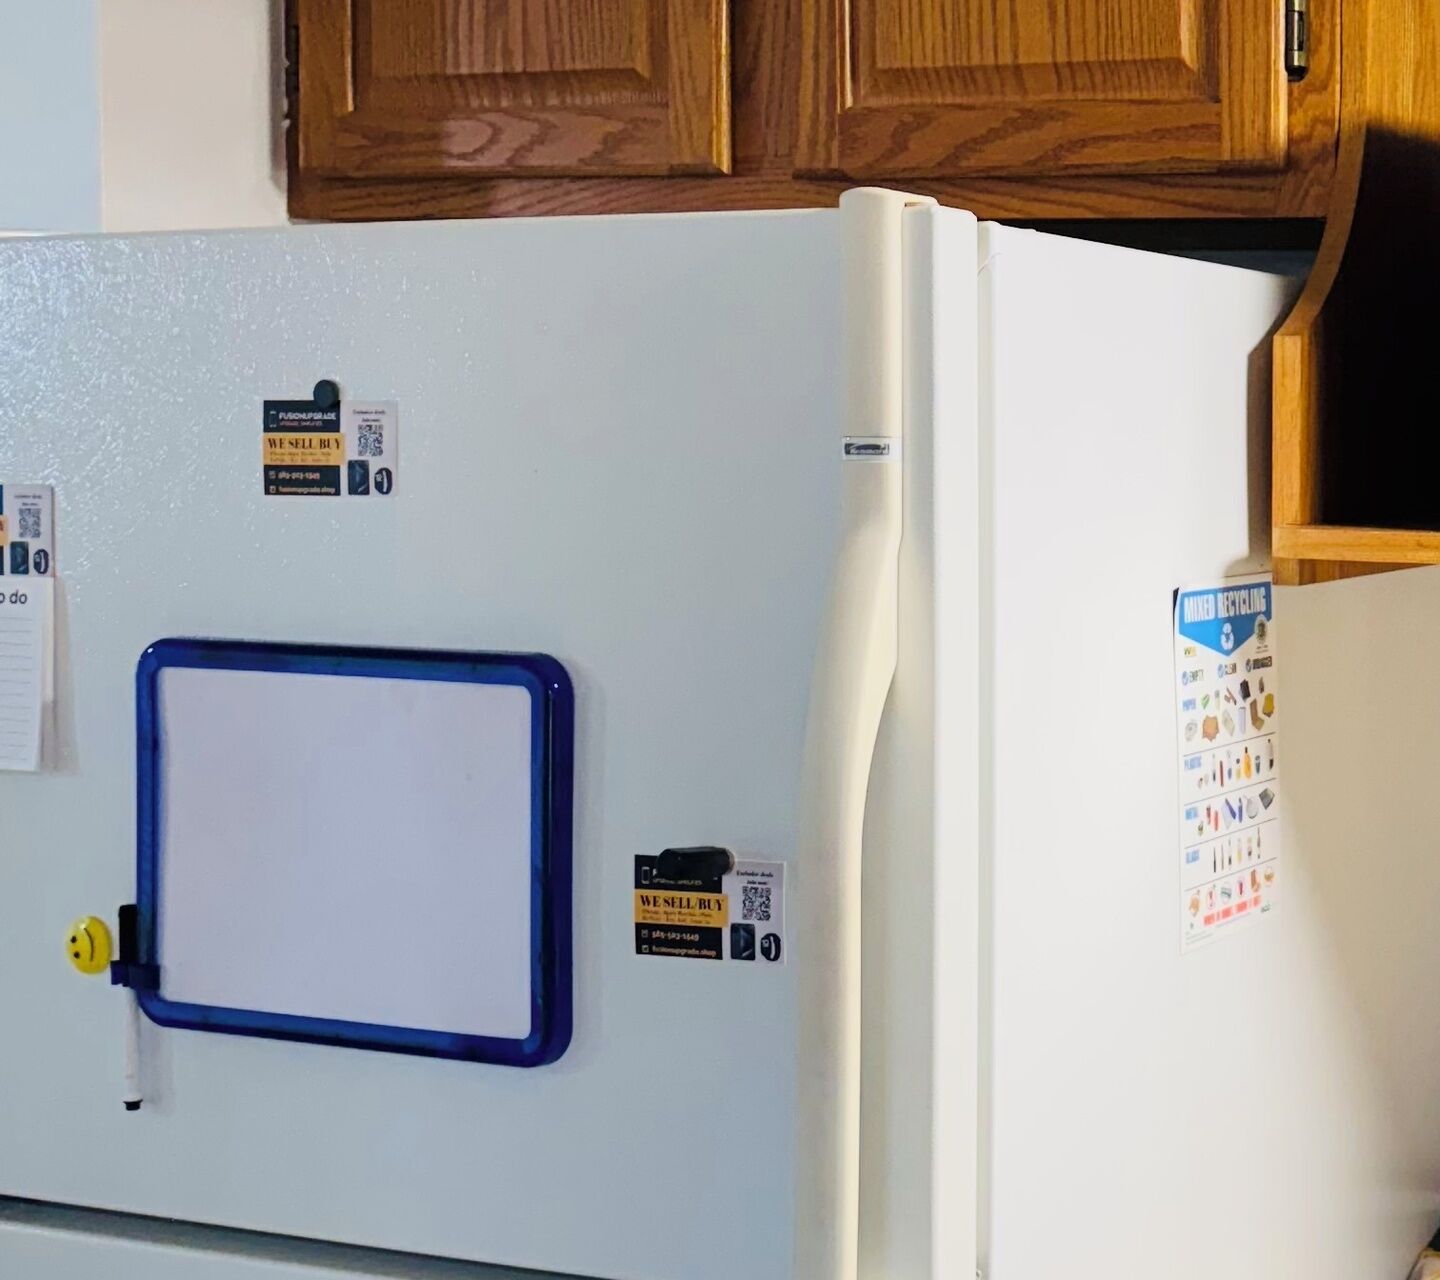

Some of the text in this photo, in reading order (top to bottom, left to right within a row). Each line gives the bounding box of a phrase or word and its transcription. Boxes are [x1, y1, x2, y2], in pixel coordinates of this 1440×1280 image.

[268, 438, 286, 449] WE
[9, 589, 28, 605] do
[1184, 587, 1266, 624] MIXED RECYCLING
[640, 895, 661, 908] WE
